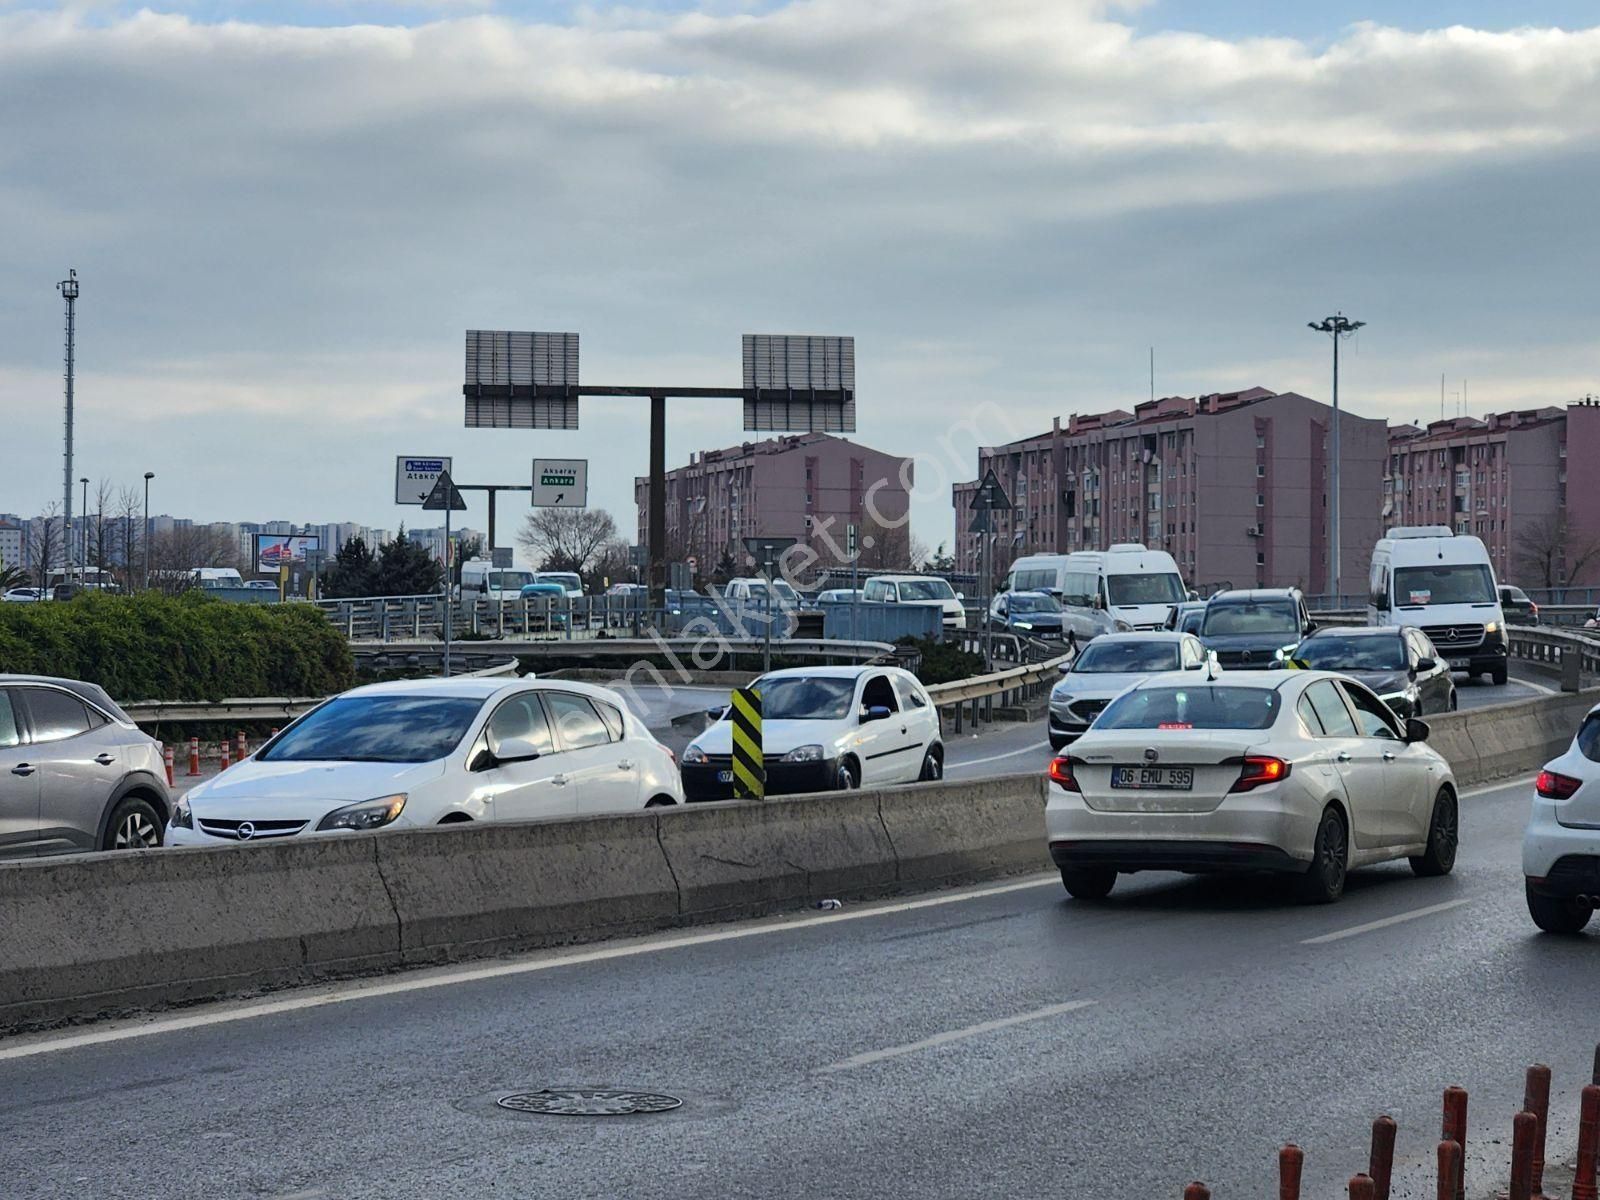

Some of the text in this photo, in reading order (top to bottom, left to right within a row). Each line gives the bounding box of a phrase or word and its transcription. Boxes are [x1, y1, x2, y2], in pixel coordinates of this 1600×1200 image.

[543, 467, 577, 475] Aksaray
[543, 477, 574, 485] Ankara
[1120, 769, 1190, 784] 06 EMU 595
